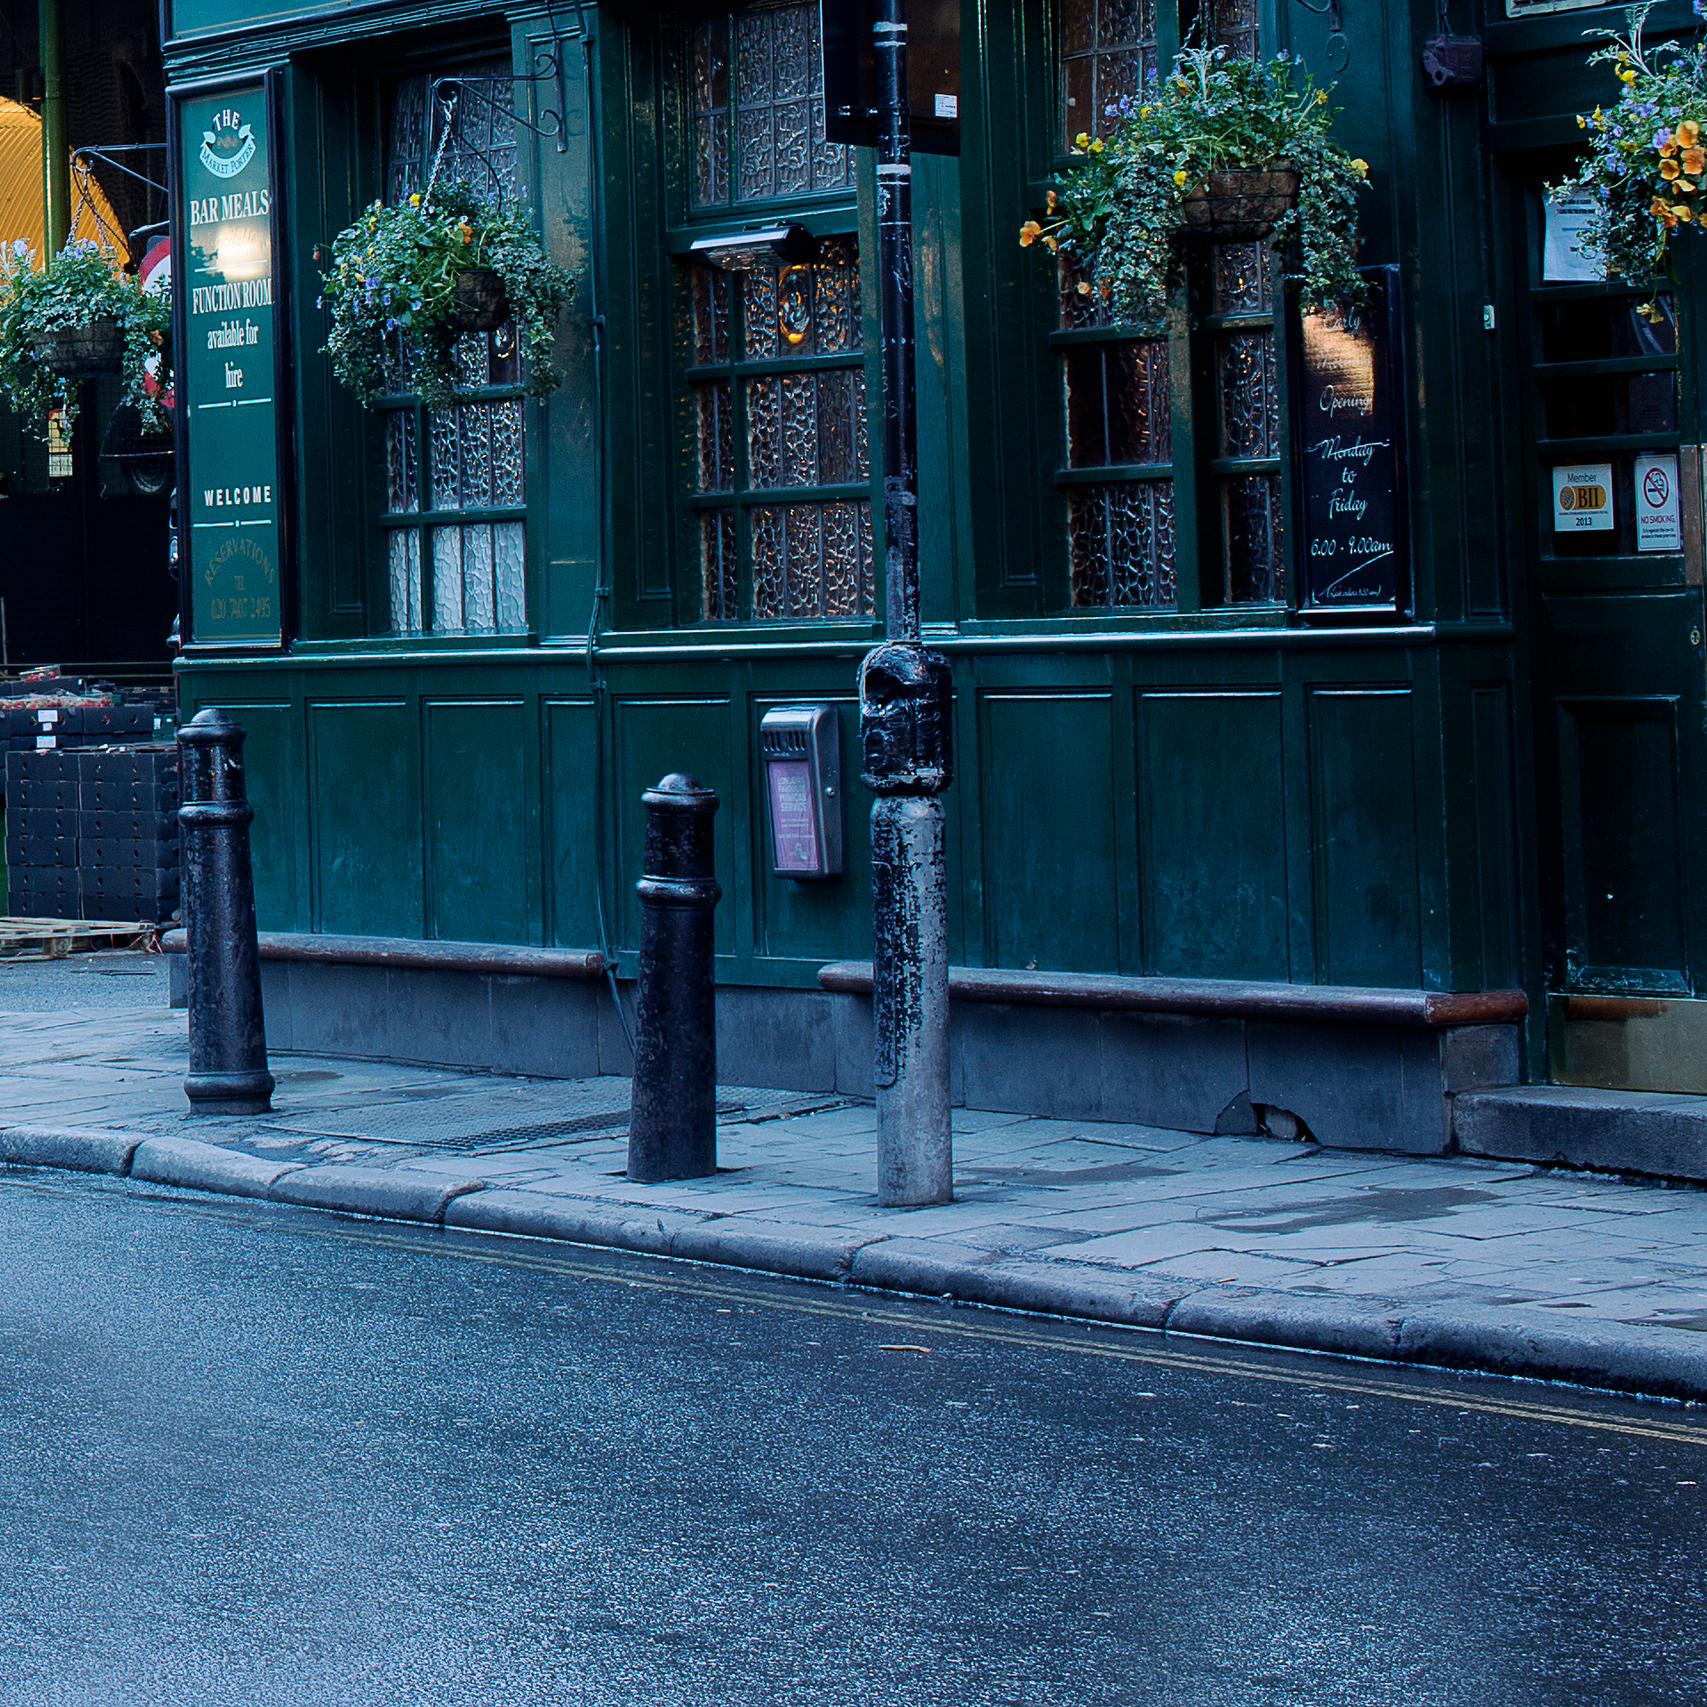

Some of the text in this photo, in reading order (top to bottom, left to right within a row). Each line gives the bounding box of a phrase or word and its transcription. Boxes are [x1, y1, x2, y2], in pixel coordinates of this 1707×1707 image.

[213, 109, 240, 132] THE
[190, 189, 270, 226] BAR MEALS
[192, 277, 272, 314] FUNCTION ROOM
[207, 318, 259, 349] available for
[225, 360, 244, 388] hire
[1319, 384, 1371, 419] Opening
[1317, 435, 1376, 467] Monday
[1341, 466, 1357, 484] to
[1567, 473, 1597, 483] Member
[204, 485, 272, 507] WELCOME
[1328, 487, 1367, 521] Friday
[1577, 487, 1600, 508] BII
[1576, 517, 1593, 526] 2013
[1640, 516, 1650, 524] NO
[204, 538, 276, 587] RESERVATIONS
